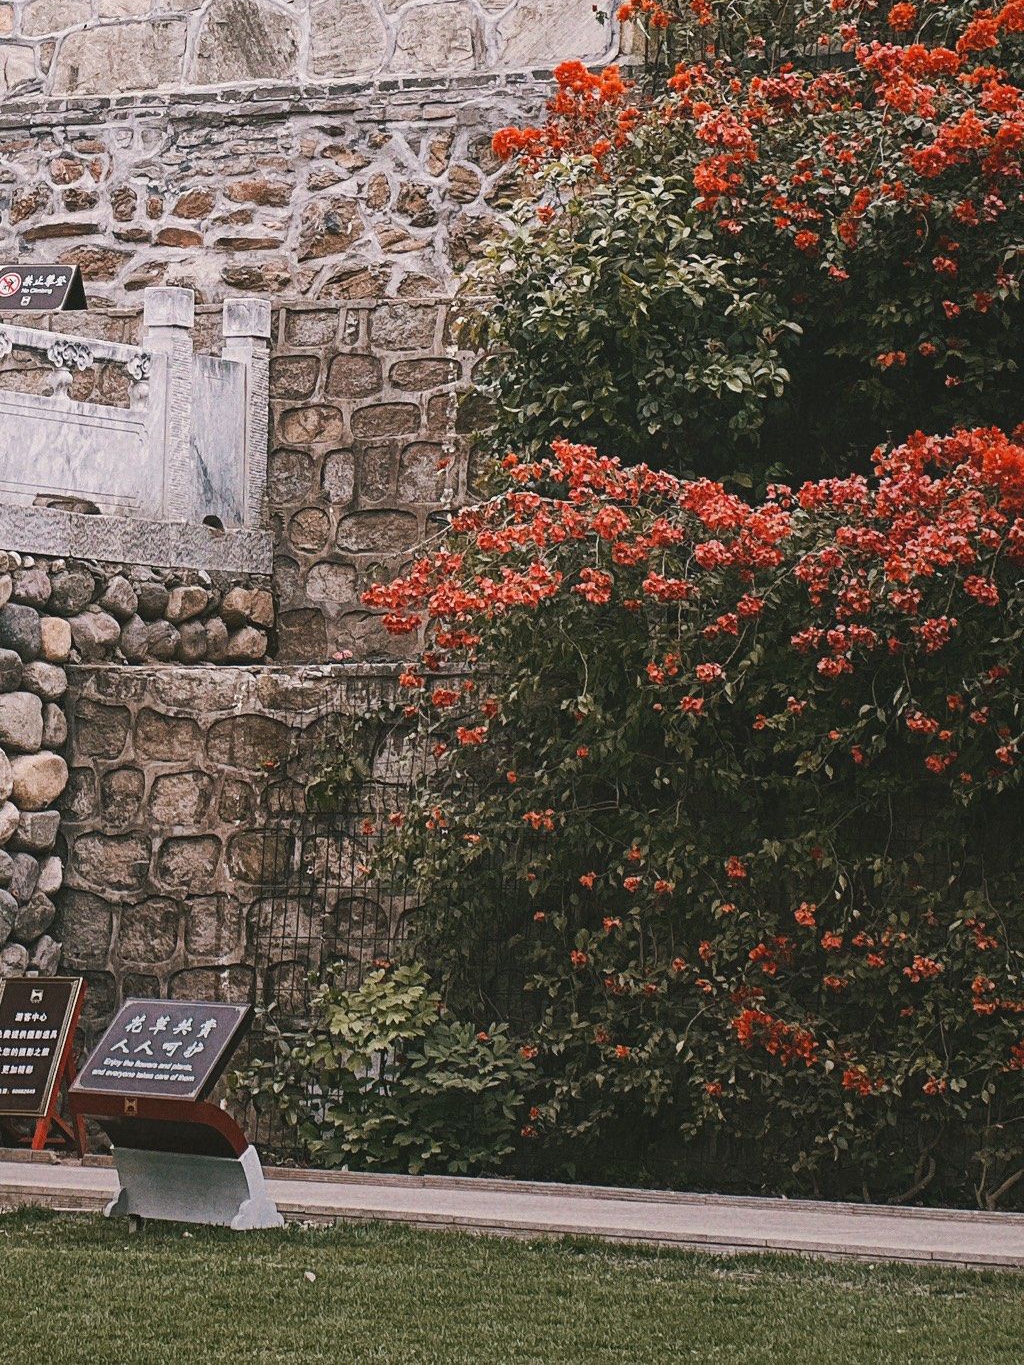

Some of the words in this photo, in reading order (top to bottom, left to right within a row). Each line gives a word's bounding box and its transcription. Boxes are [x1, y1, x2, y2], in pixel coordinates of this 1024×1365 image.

[103, 1057, 123, 1067] Enjoy
[122, 1059, 134, 1067] the
[92, 1068, 106, 1076] and
